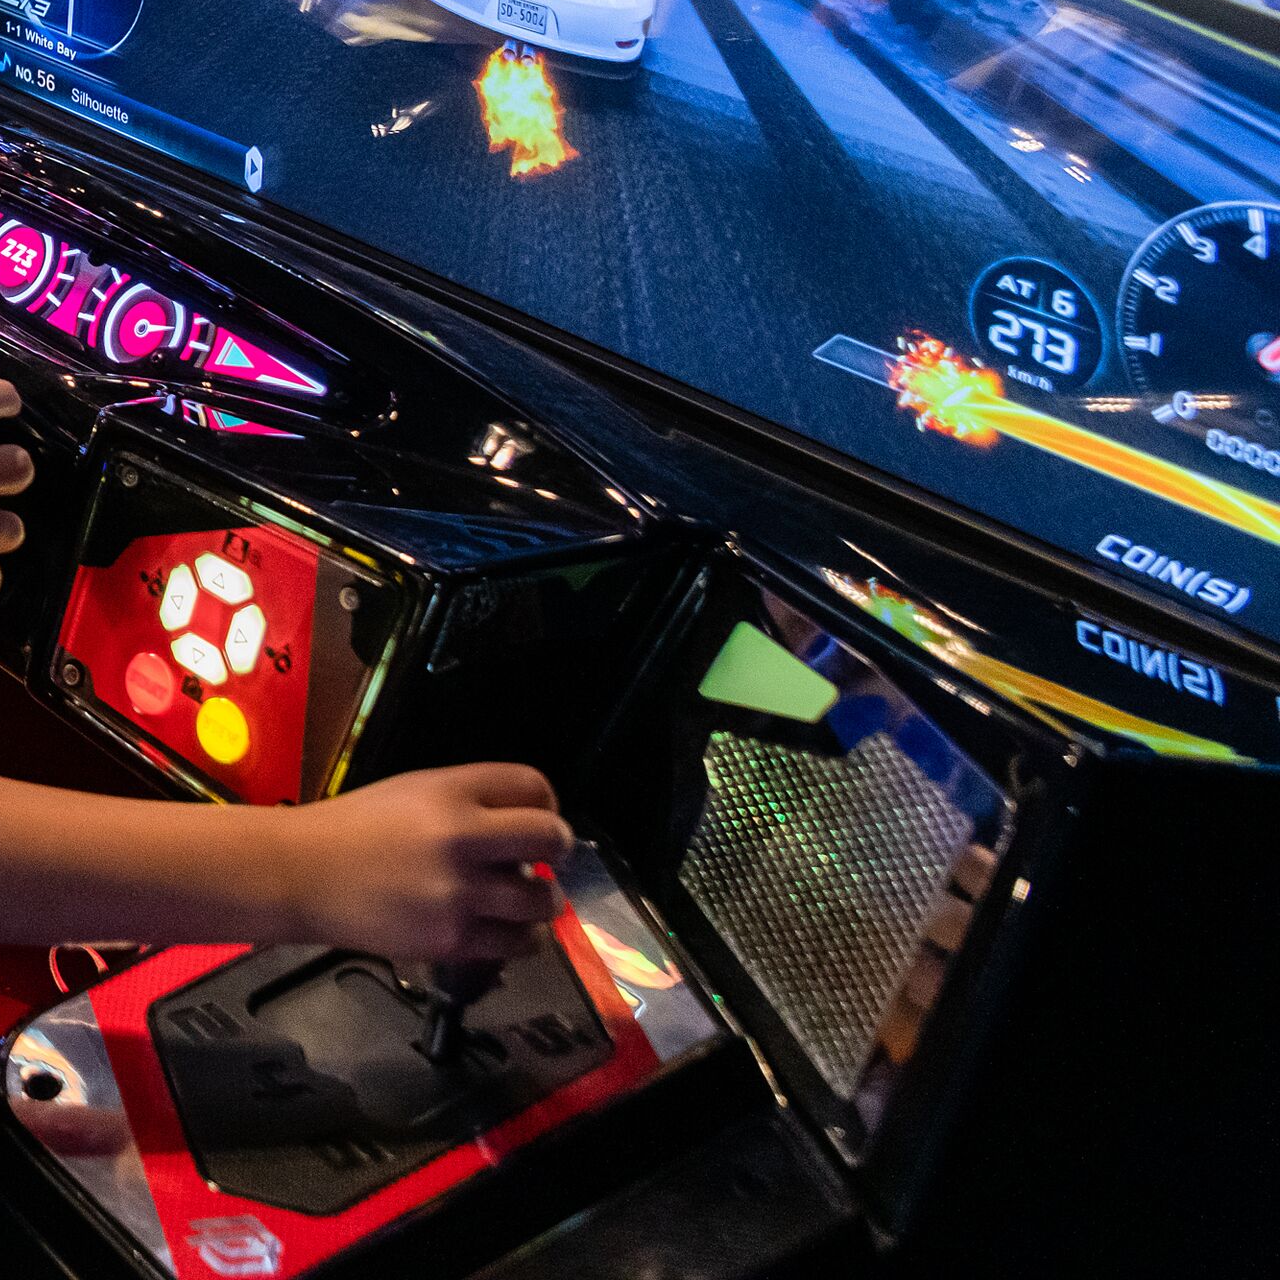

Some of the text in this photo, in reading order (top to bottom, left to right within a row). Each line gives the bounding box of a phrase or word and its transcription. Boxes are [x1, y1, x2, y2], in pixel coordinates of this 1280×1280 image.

[6, 21, 77, 61] 1-1 White Bay
[15, 64, 129, 124] NO. 56 Silhouette
[0, 238, 38, 269] 223
[1193, 237, 1219, 263] 3
[1243, 234, 1269, 261] 4
[996, 274, 1079, 319] AT 6
[1154, 275, 1182, 305] 2
[988, 309, 1079, 375] 273
[1148, 332, 1164, 357] 1
[1171, 390, 1198, 420] 0
[1095, 533, 1254, 615] COIN(S)
